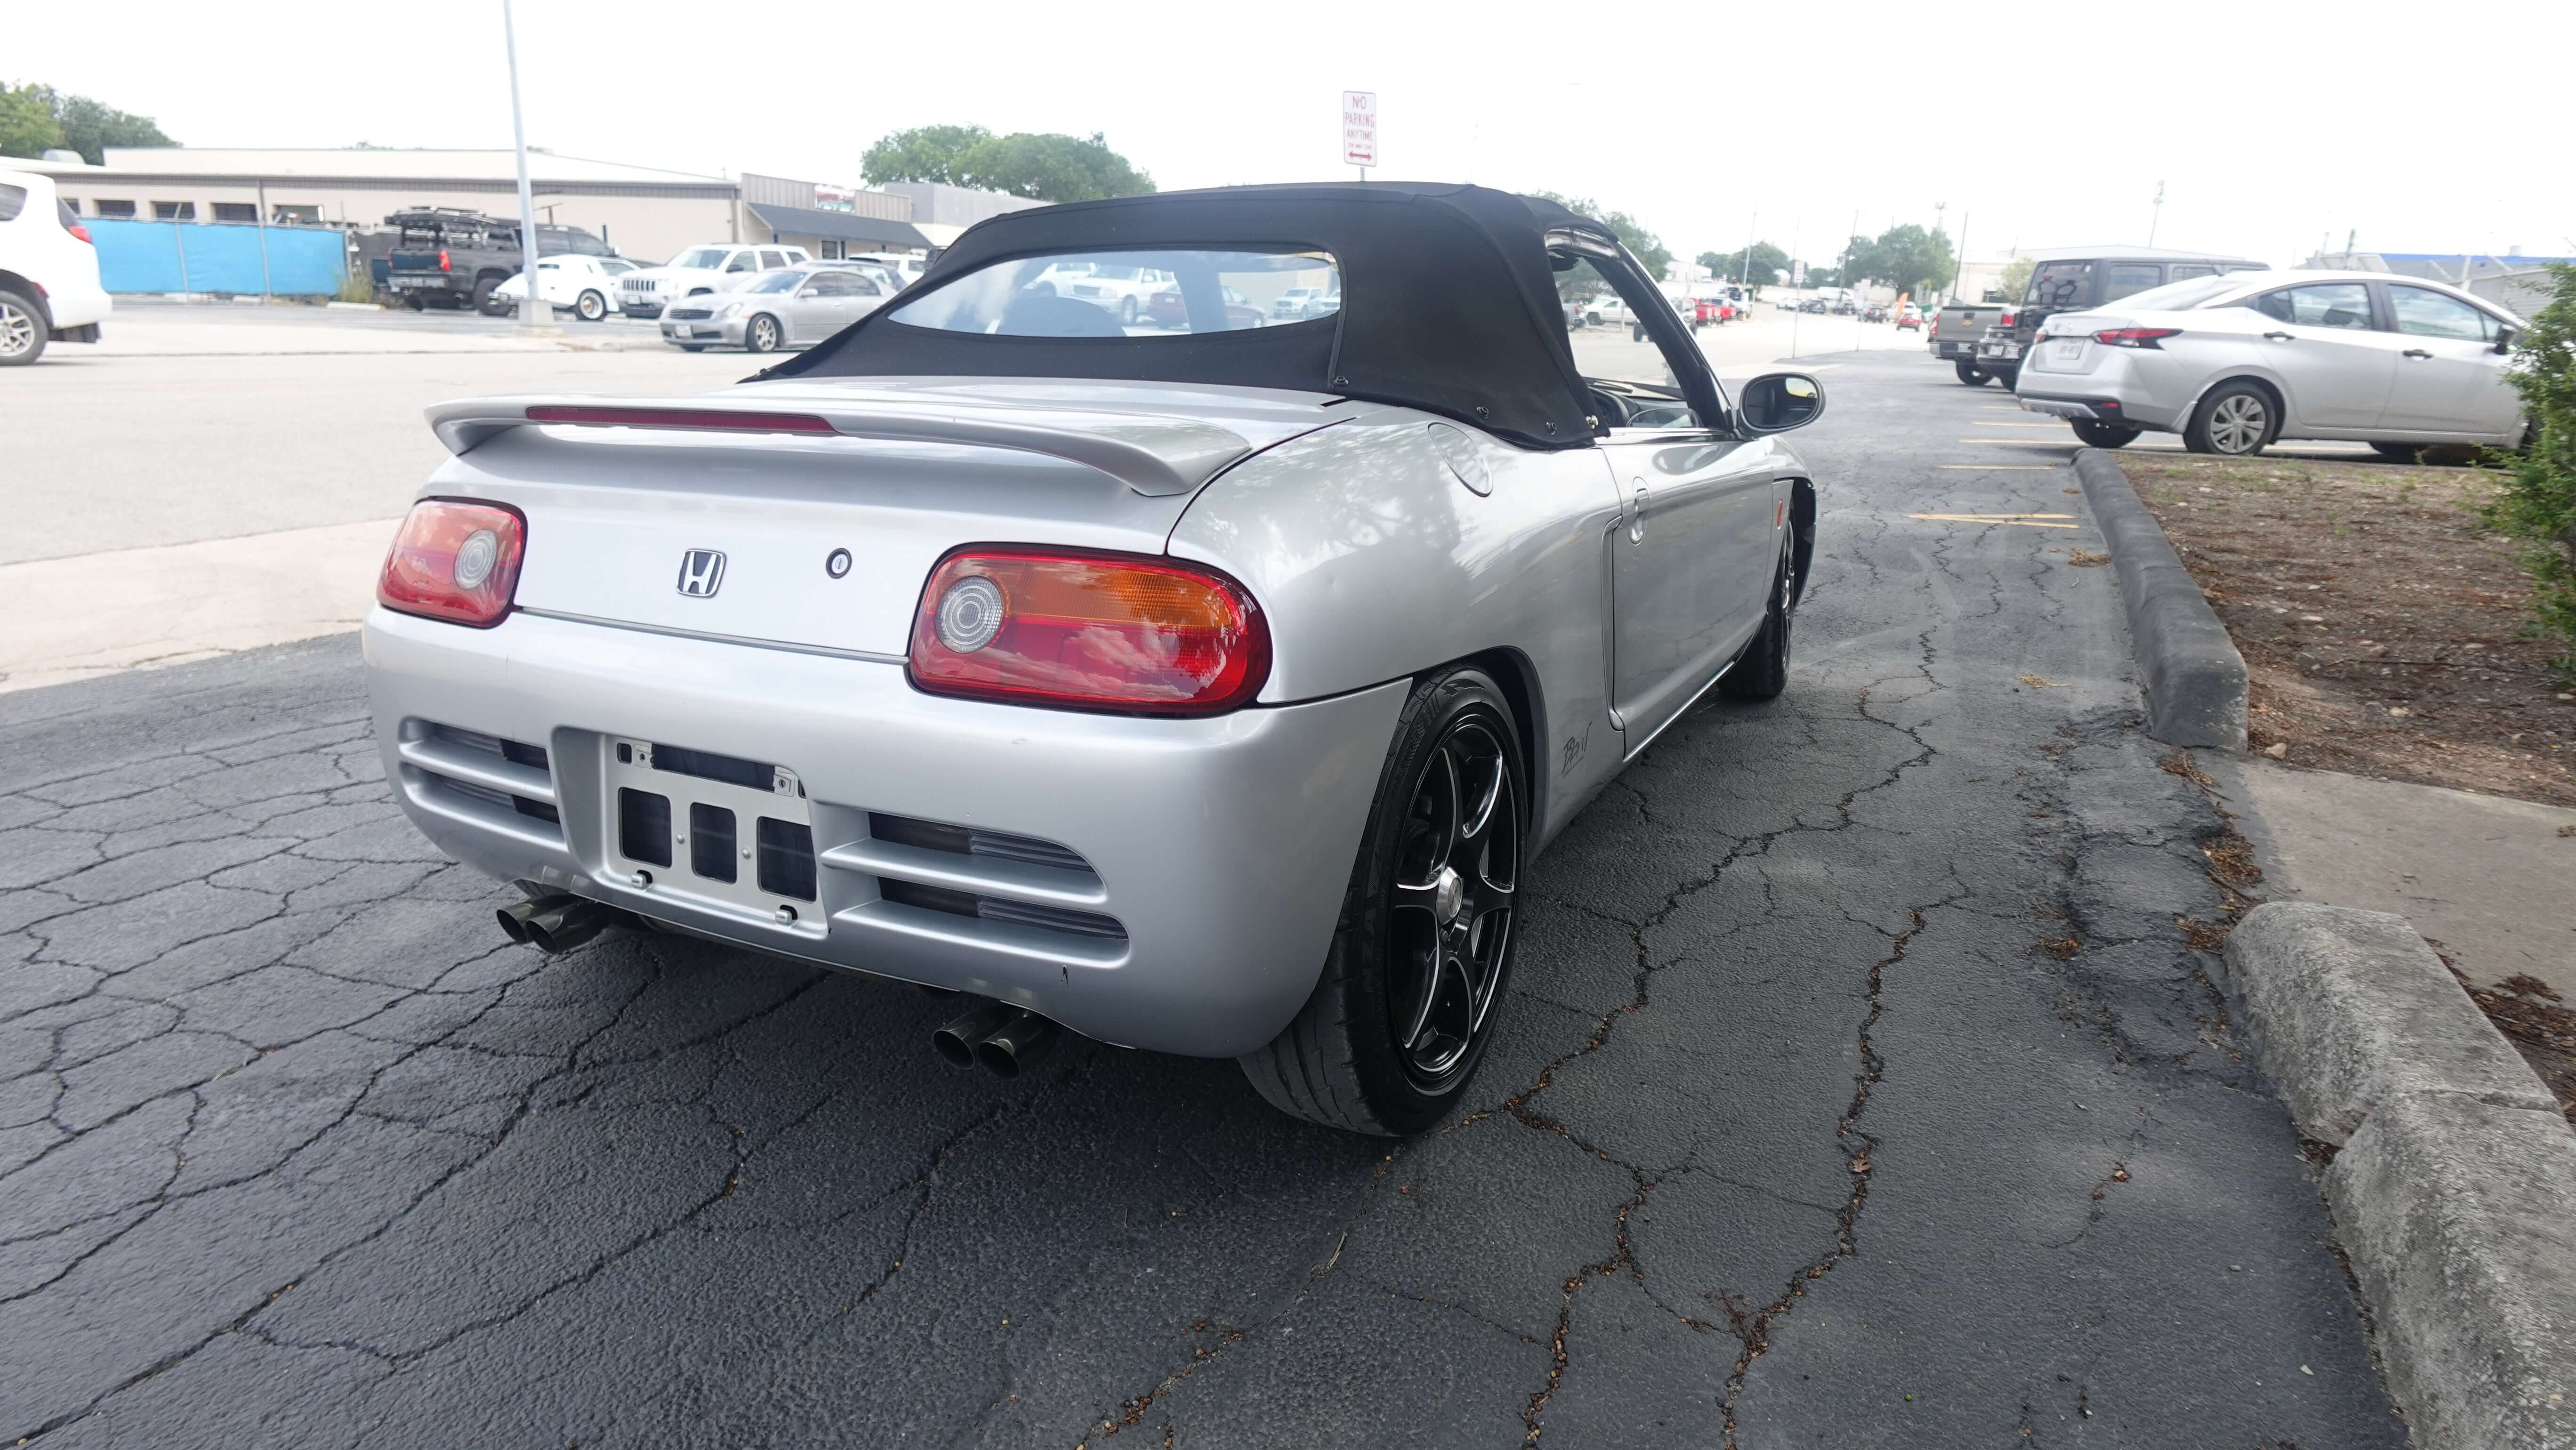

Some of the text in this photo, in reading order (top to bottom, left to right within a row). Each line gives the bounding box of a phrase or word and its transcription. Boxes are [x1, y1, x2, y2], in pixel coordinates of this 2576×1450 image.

[1352, 96, 1367, 110] NO
[1345, 112, 1375, 128] PARKING
[1347, 129, 1373, 141] ANYTIME
[683, 551, 716, 595] H
